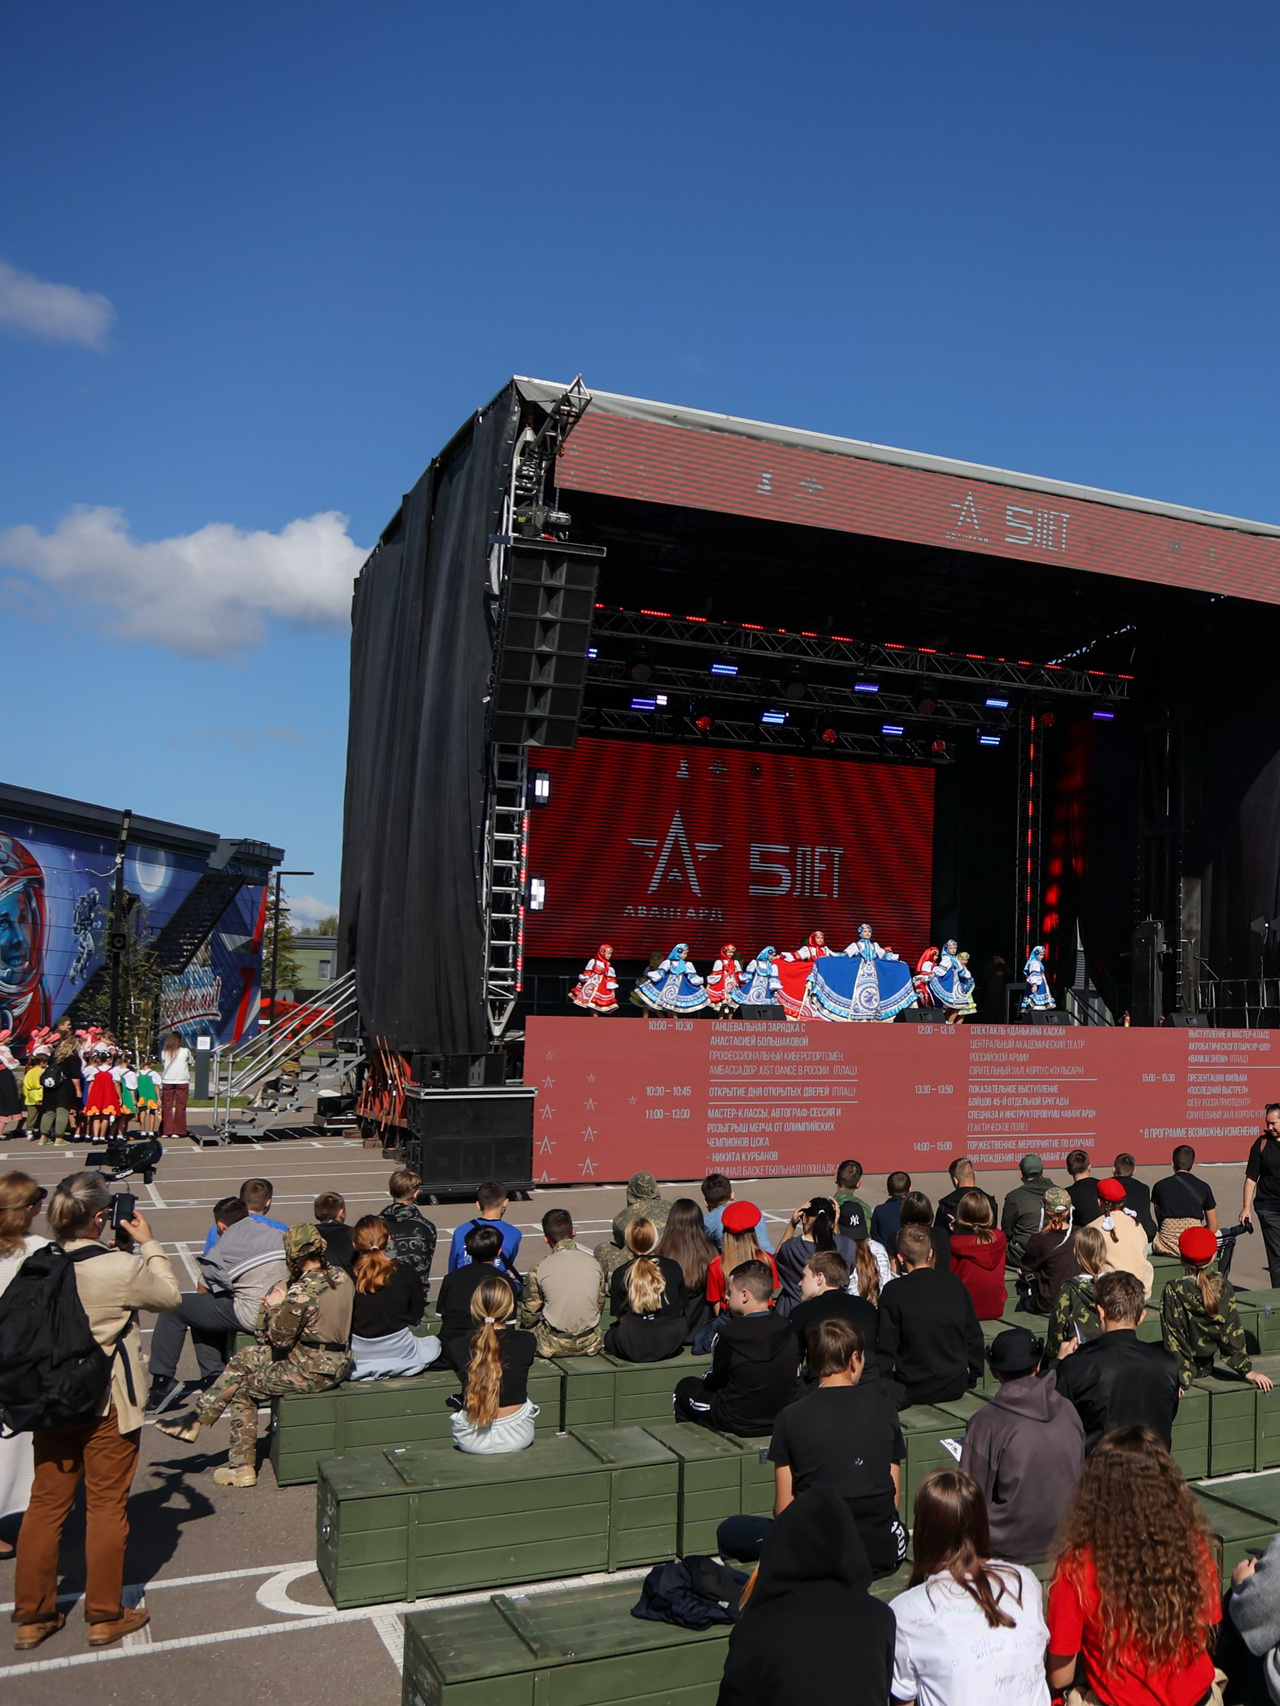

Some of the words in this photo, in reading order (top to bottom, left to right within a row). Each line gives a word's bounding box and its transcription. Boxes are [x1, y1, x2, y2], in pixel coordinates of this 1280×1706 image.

[749, 843, 791, 896] 5
[793, 846, 844, 899] ЛЕТ
[649, 1022, 666, 1030] 10:00
[675, 1022, 693, 1030] 10:30
[711, 1022, 766, 1032] ТАНЦЕВАЛЬНАЯ
[767, 1023, 799, 1033] ЗАРЯДКА
[917, 1026, 933, 1035] 12:00
[940, 1026, 955, 1035] 13:15
[970, 1026, 1006, 1035] СПЕКТАКЛЬ
[710, 1036, 756, 1047] АНАСТАСИЕЙ
[757, 1036, 808, 1047] БОЛЬШАКОВОЙ
[970, 1039, 1014, 1049] ЦЕНТРАЛЬНЫЙ
[1015, 1039, 1065, 1049] АКАДЕМИЧЕСКИЙ
[709, 1050, 783, 1060] ПРОФЕССИОНАЛЬНЫЙ
[970, 1052, 1008, 1061] РОССИЙСКОЙ
[709, 1065, 757, 1075] АМБАССАДОР
[759, 1066, 773, 1075] JUST
[775, 1066, 796, 1075] DANCE
[804, 1066, 829, 1075] РОССИИ
[1142, 1074, 1155, 1082] 15:00
[1162, 1074, 1175, 1082] 15:30
[1188, 1074, 1224, 1082] ПРЕЗЕНТАЦИЯ
[1225, 1074, 1247, 1082] ФИЛЬМА
[646, 1086, 664, 1095] 10:30
[673, 1086, 691, 1095] 10:45
[709, 1087, 746, 1096] ОТКРЫТИЕ
[748, 1087, 762, 1097] ДНЯ
[763, 1087, 801, 1096] ОТКРЫТЫХ
[803, 1086, 829, 1097] ДВЕРЕЙ
[915, 1085, 930, 1094] 13:30
[938, 1085, 953, 1094] 13:50
[968, 1085, 1017, 1094] ПОКАЗАТЕЛЬНОЕ
[1018, 1085, 1058, 1093] ВЫСТУПЛЕНИЕ
[968, 1097, 991, 1107] БОЙЦОВ
[1007, 1096, 1041, 1106] ОТДЕЛЬНОЙ
[1042, 1097, 1069, 1105] БРИГАДЫ
[646, 1109, 663, 1118] 11:00
[672, 1109, 690, 1118] 13:00
[771, 1108, 835, 1118] АВТОГРАФ-СЕССИЯ
[968, 1110, 998, 1119] СПЕЦНАЗА
[707, 1123, 748, 1133] РОЗЫГРЫШ
[749, 1123, 772, 1133] МЕРЧА
[773, 1123, 783, 1132] ОТ
[784, 1122, 834, 1132] ОЛИМПИЙСКИХ
[1150, 1128, 1187, 1138] ПРОГРАММЕ
[1188, 1127, 1224, 1137] ВОЗМОЖНЫ
[1225, 1126, 1260, 1136] ИЗМЕНЕНИЯ
[707, 1138, 749, 1147] ЧЕМПИОНОВ
[750, 1137, 769, 1147] ЦСКА
[914, 1142, 929, 1151] 14:00
[937, 1142, 952, 1150] 15:00
[967, 1140, 1017, 1149] ТОРЖЕСТВЕННОЕ
[1018, 1139, 1059, 1149] МЕРОПРИЯТИЕ
[1060, 1139, 1068, 1148] ПО
[1069, 1139, 1094, 1147] СЛУЧАЮ
[712, 1152, 740, 1162] НИКИТА
[741, 1151, 778, 1161] КУРБАНОВ
[979, 1154, 1014, 1163] РОЖДЕНИЯ
[742, 1165, 799, 1175] БАСКЕТБОЛЬНАЯ
